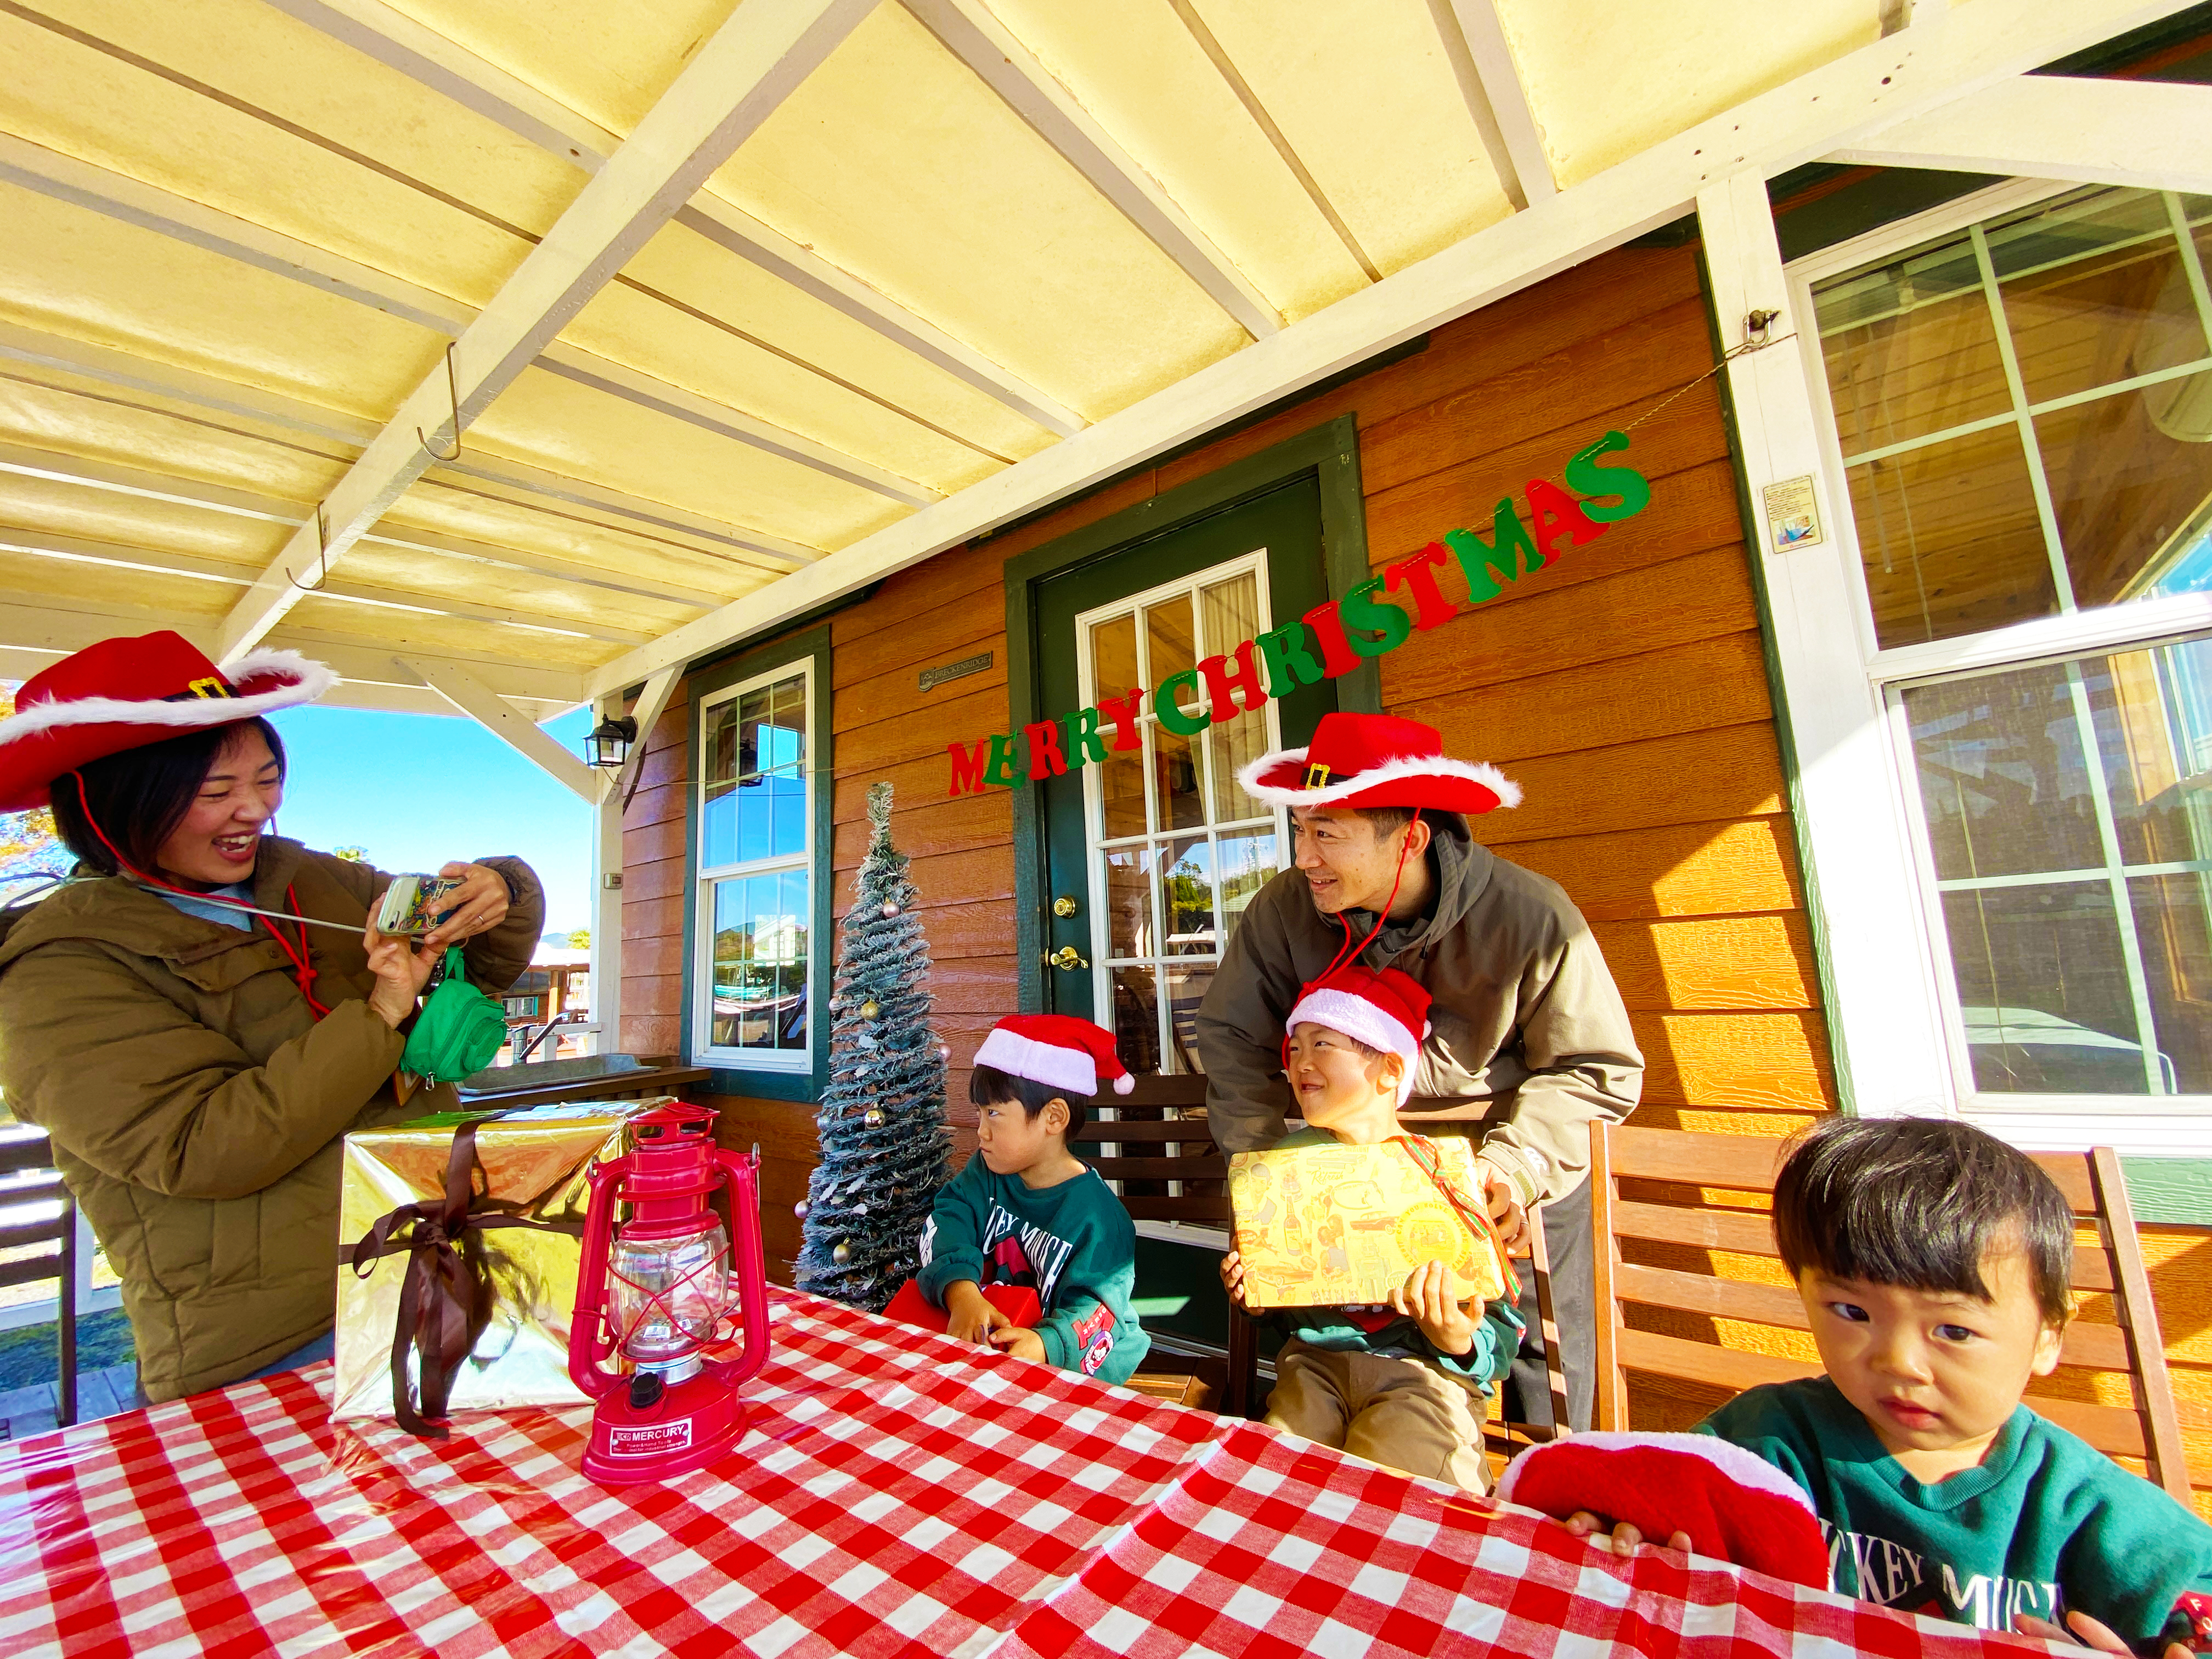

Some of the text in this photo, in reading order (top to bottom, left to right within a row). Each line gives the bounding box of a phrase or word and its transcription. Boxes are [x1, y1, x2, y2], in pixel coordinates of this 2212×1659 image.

[947, 431, 1651, 796] MERRY CHRISTMAS
[934, 656, 988, 679] BRECKENRIDGE
[1311, 1170, 1344, 1185] Refresh
[1405, 1204, 1419, 1216] YOU
[1424, 1203, 1448, 1214] SOLVE
[1396, 1218, 1405, 1234] CAN
[1453, 1215, 1468, 1243] THESE
[1452, 1249, 1467, 1270] SIMP
[632, 1425, 684, 1441] MERCURY
